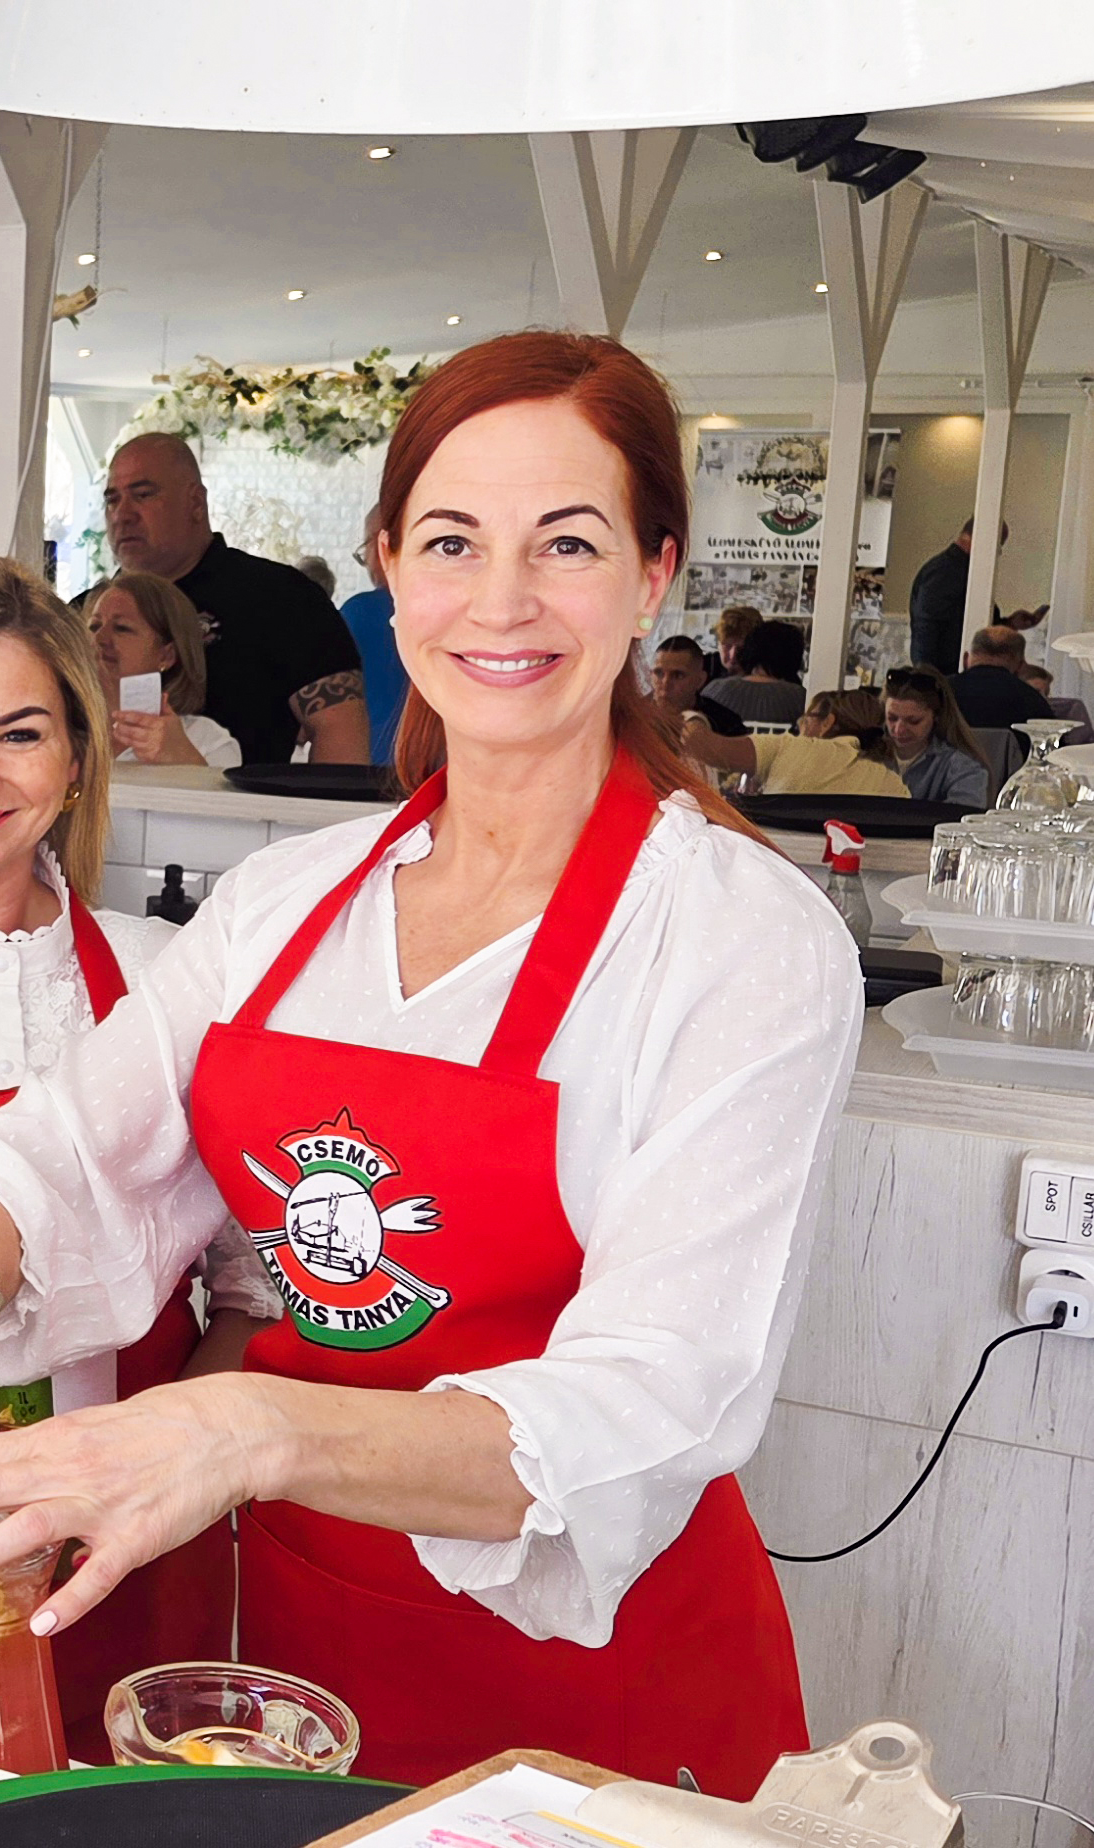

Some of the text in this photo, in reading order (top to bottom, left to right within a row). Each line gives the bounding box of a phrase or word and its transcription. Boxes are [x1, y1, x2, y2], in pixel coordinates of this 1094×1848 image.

[297, 1139, 383, 1177] CSEMŐ
[1045, 1180, 1058, 1212] SPOT
[336, 1290, 414, 1331] TANYA
